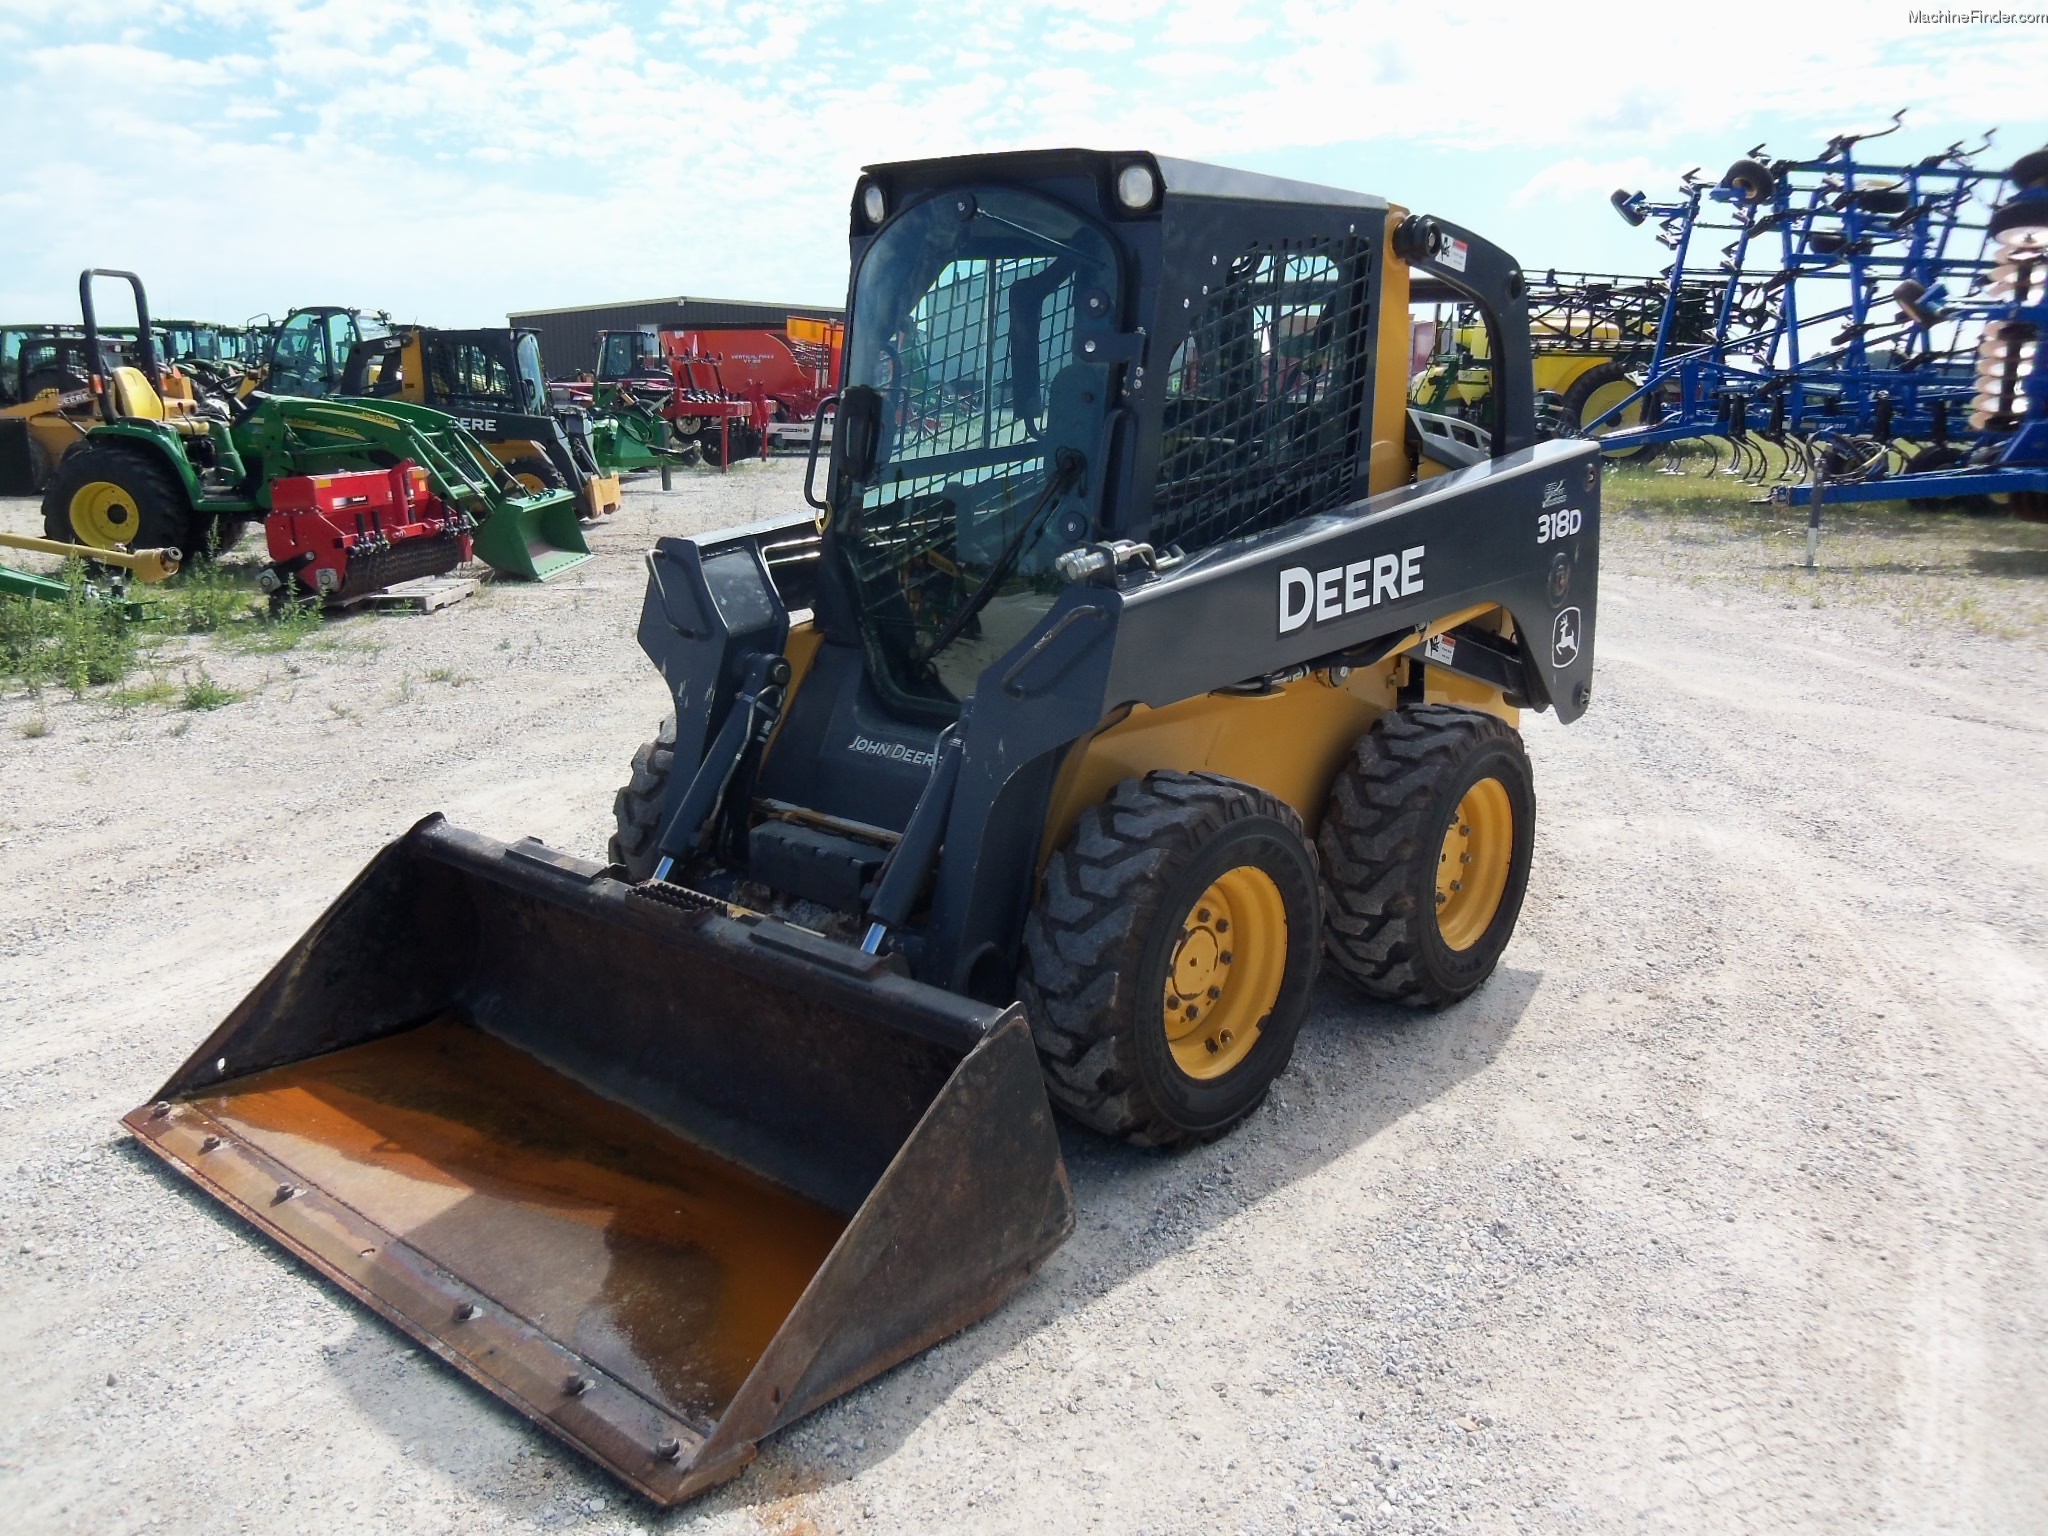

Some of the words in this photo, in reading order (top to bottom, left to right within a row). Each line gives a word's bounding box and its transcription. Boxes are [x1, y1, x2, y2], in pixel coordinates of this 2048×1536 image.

[1537, 508, 1581, 544] 318D
[1280, 545, 1425, 633] DEERE
[848, 735, 891, 756] JOHN
[890, 743, 943, 767] DEER
